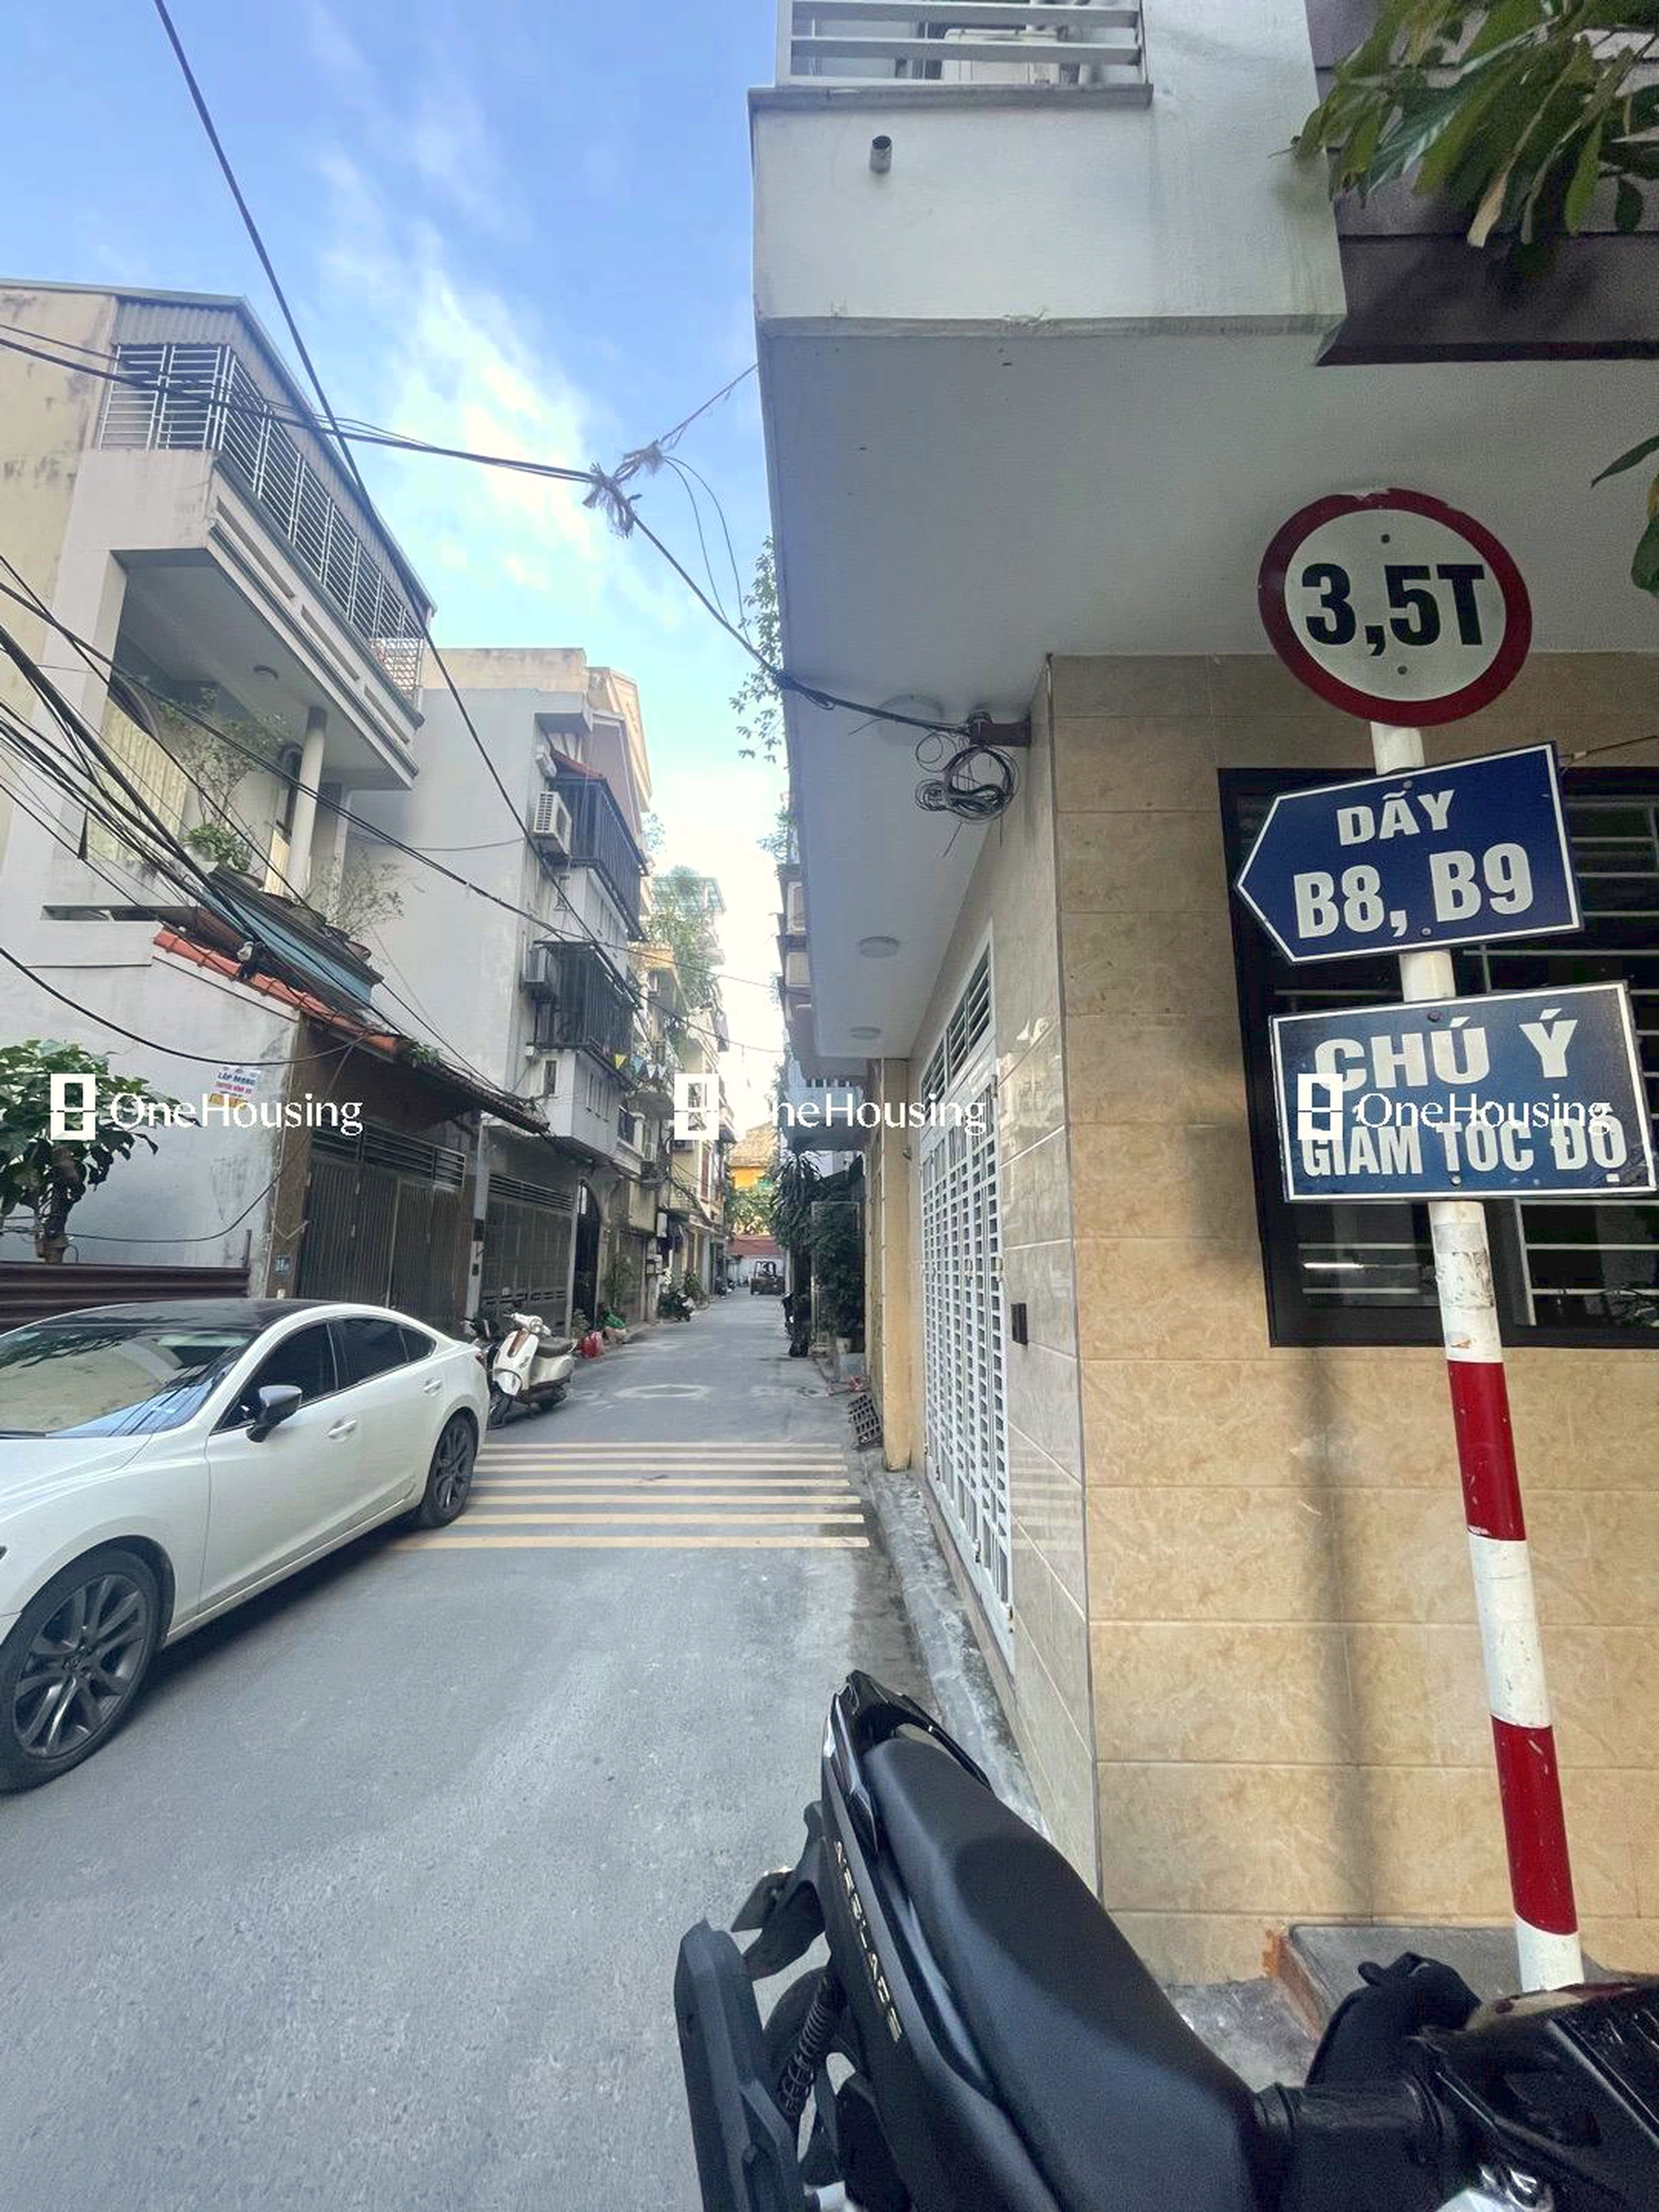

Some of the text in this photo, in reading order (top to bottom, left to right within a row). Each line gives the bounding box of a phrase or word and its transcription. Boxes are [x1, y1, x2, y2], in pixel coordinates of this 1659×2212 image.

[1301, 563, 1485, 656] 3,5T
[1336, 789, 1455, 846] DÃY
[1294, 843, 1534, 939] B8, B9
[1314, 1008, 1578, 1092] CHÚ Ý
